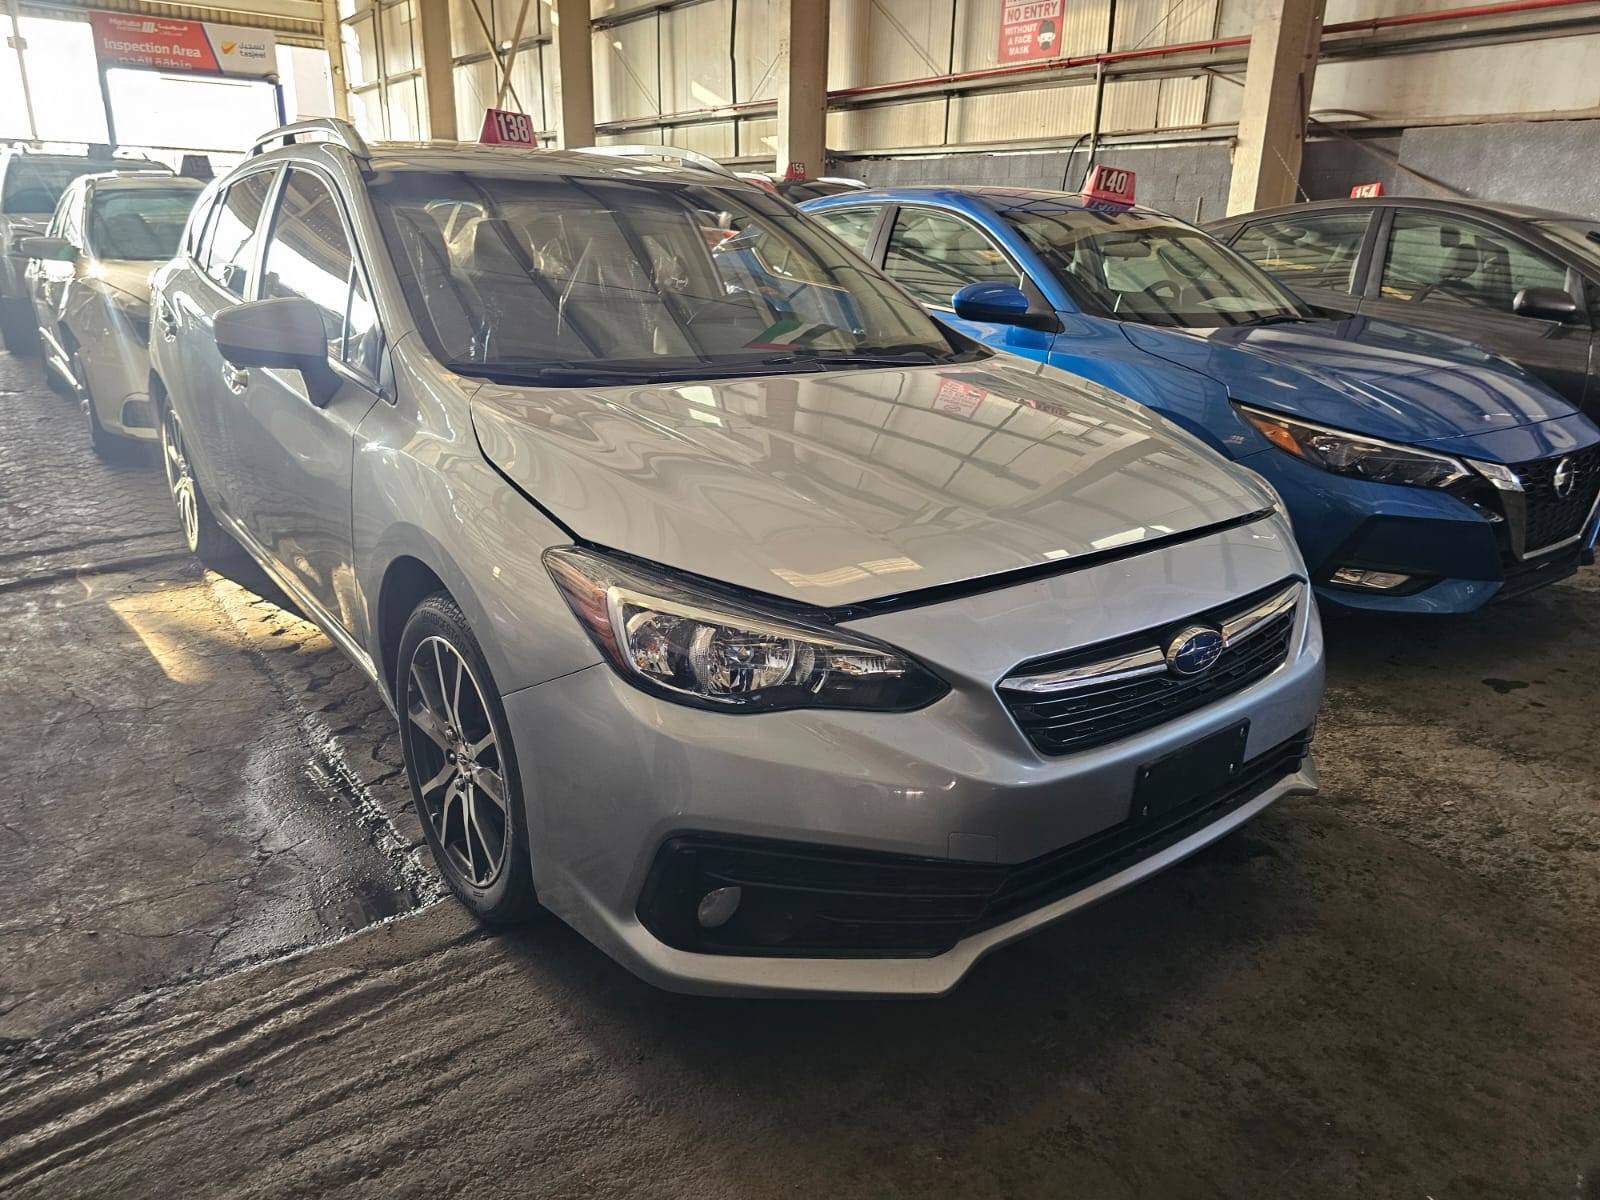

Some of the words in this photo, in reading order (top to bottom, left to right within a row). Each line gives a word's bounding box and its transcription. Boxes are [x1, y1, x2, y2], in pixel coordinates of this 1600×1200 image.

[1007, 8, 1021, 22] NO
[1023, 1, 1058, 19] ENTRY
[1005, 23, 1037, 36] WITHOUT
[103, 37, 170, 55] Inspection
[173, 44, 201, 57] Area
[1007, 37, 1013, 46] A
[1014, 34, 1032, 44] FACE
[1008, 45, 1030, 56] MASK
[498, 113, 530, 142] 138
[1100, 170, 1128, 194] 140
